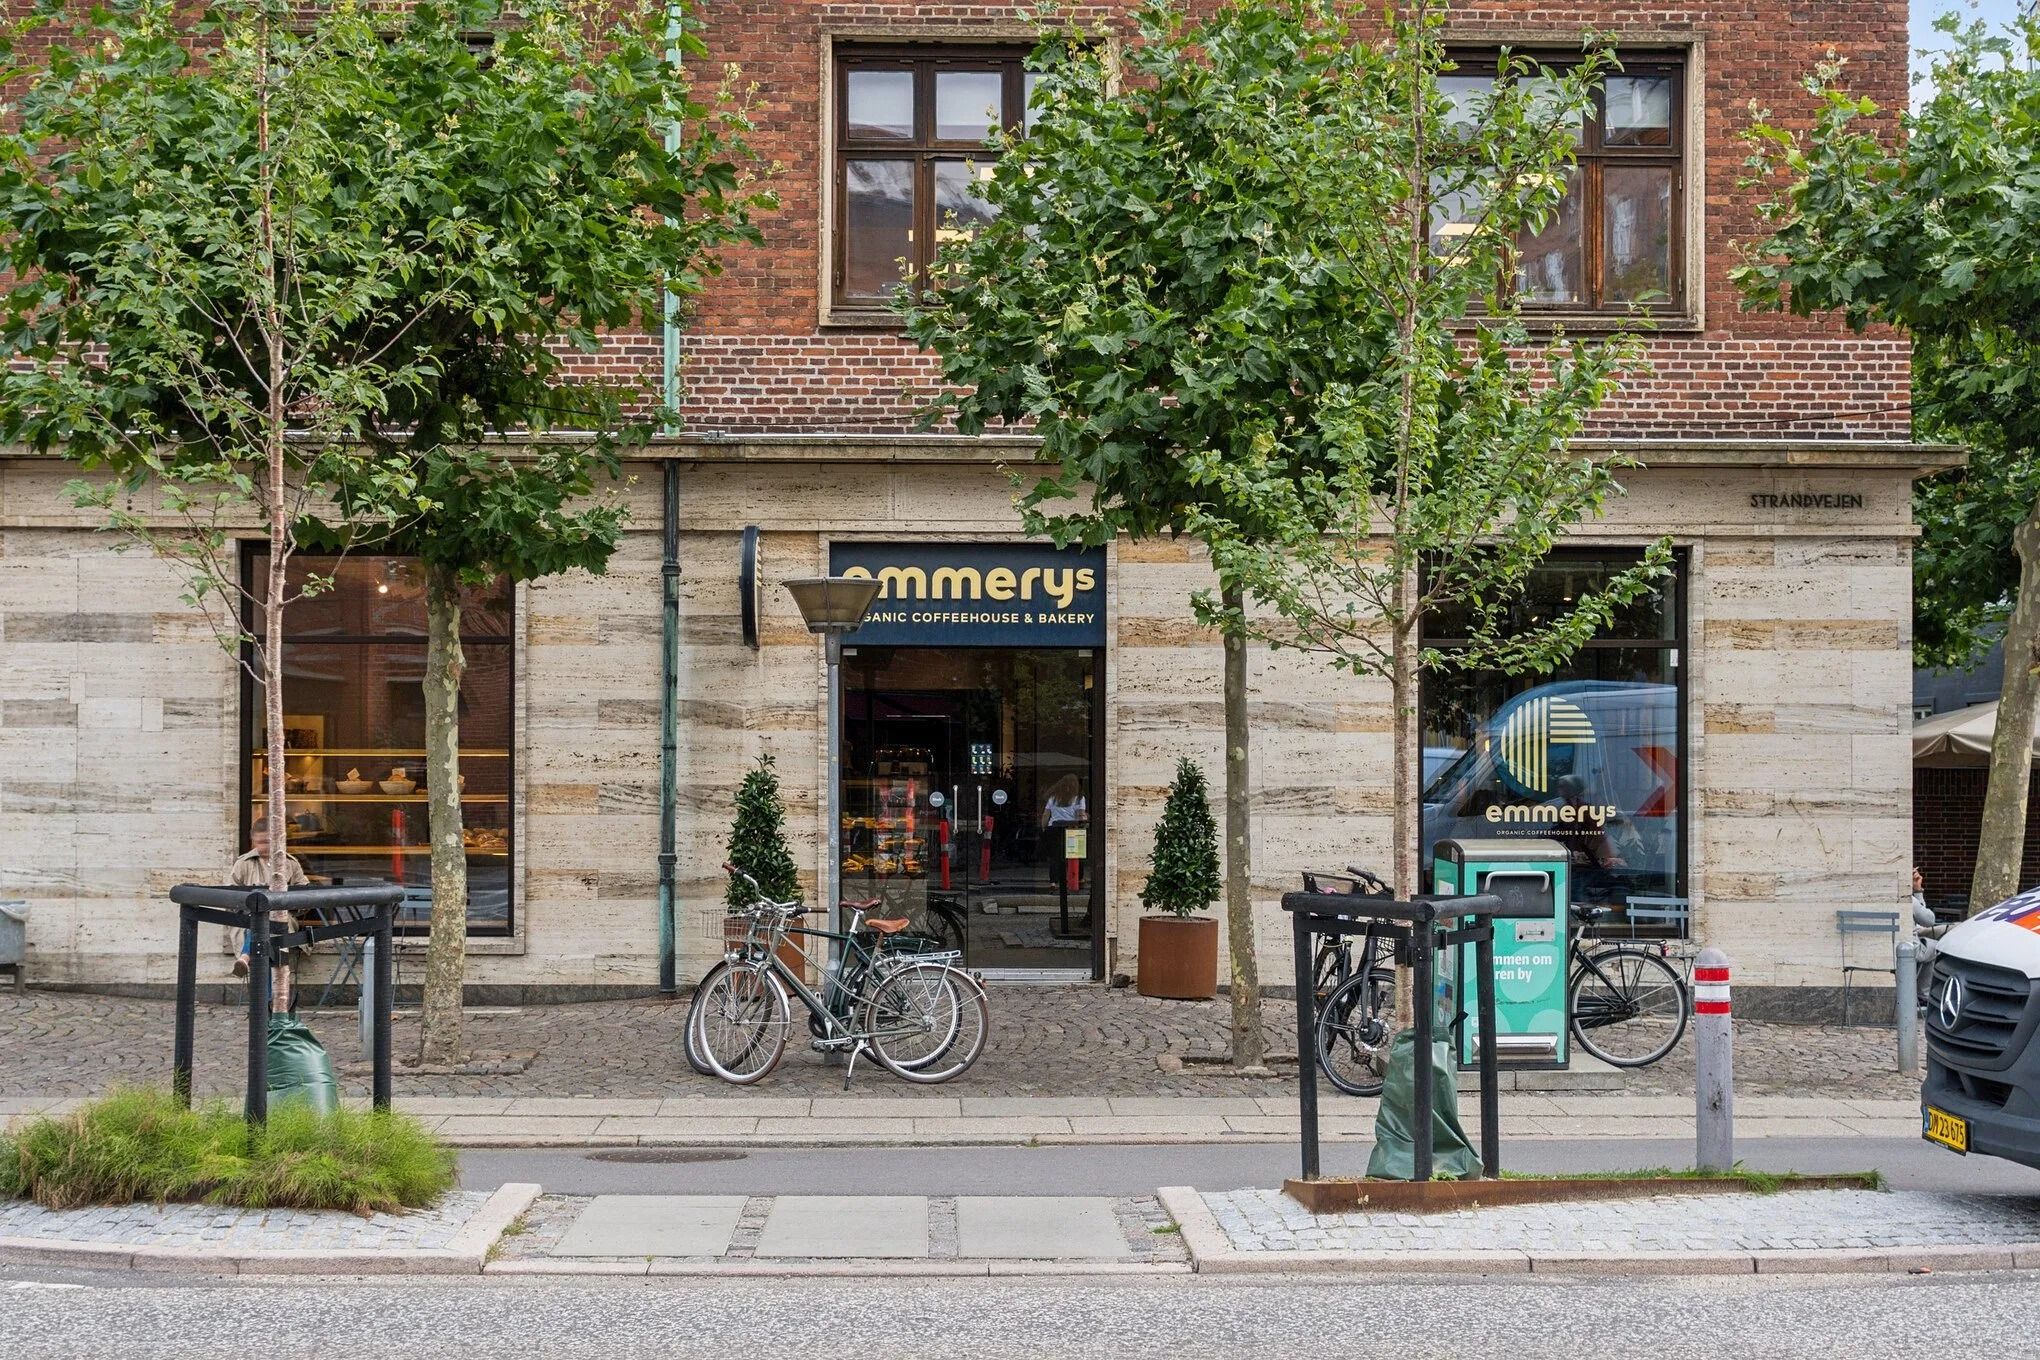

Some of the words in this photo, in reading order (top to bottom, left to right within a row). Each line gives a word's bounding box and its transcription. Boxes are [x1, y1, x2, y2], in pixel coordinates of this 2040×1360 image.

[1750, 494, 1863, 508] STRANDVEJEN
[863, 612, 907, 623] GANIC
[911, 612, 1019, 623] COFFEEHOUSE
[1024, 613, 1033, 624] &
[1038, 613, 1095, 624] BAKERY
[1485, 805, 1617, 827] emmerys
[1493, 955, 1530, 965] mmen
[1532, 955, 1552, 965] om
[1517, 967, 1533, 983] by
[1950, 1121, 1965, 1145] 675
